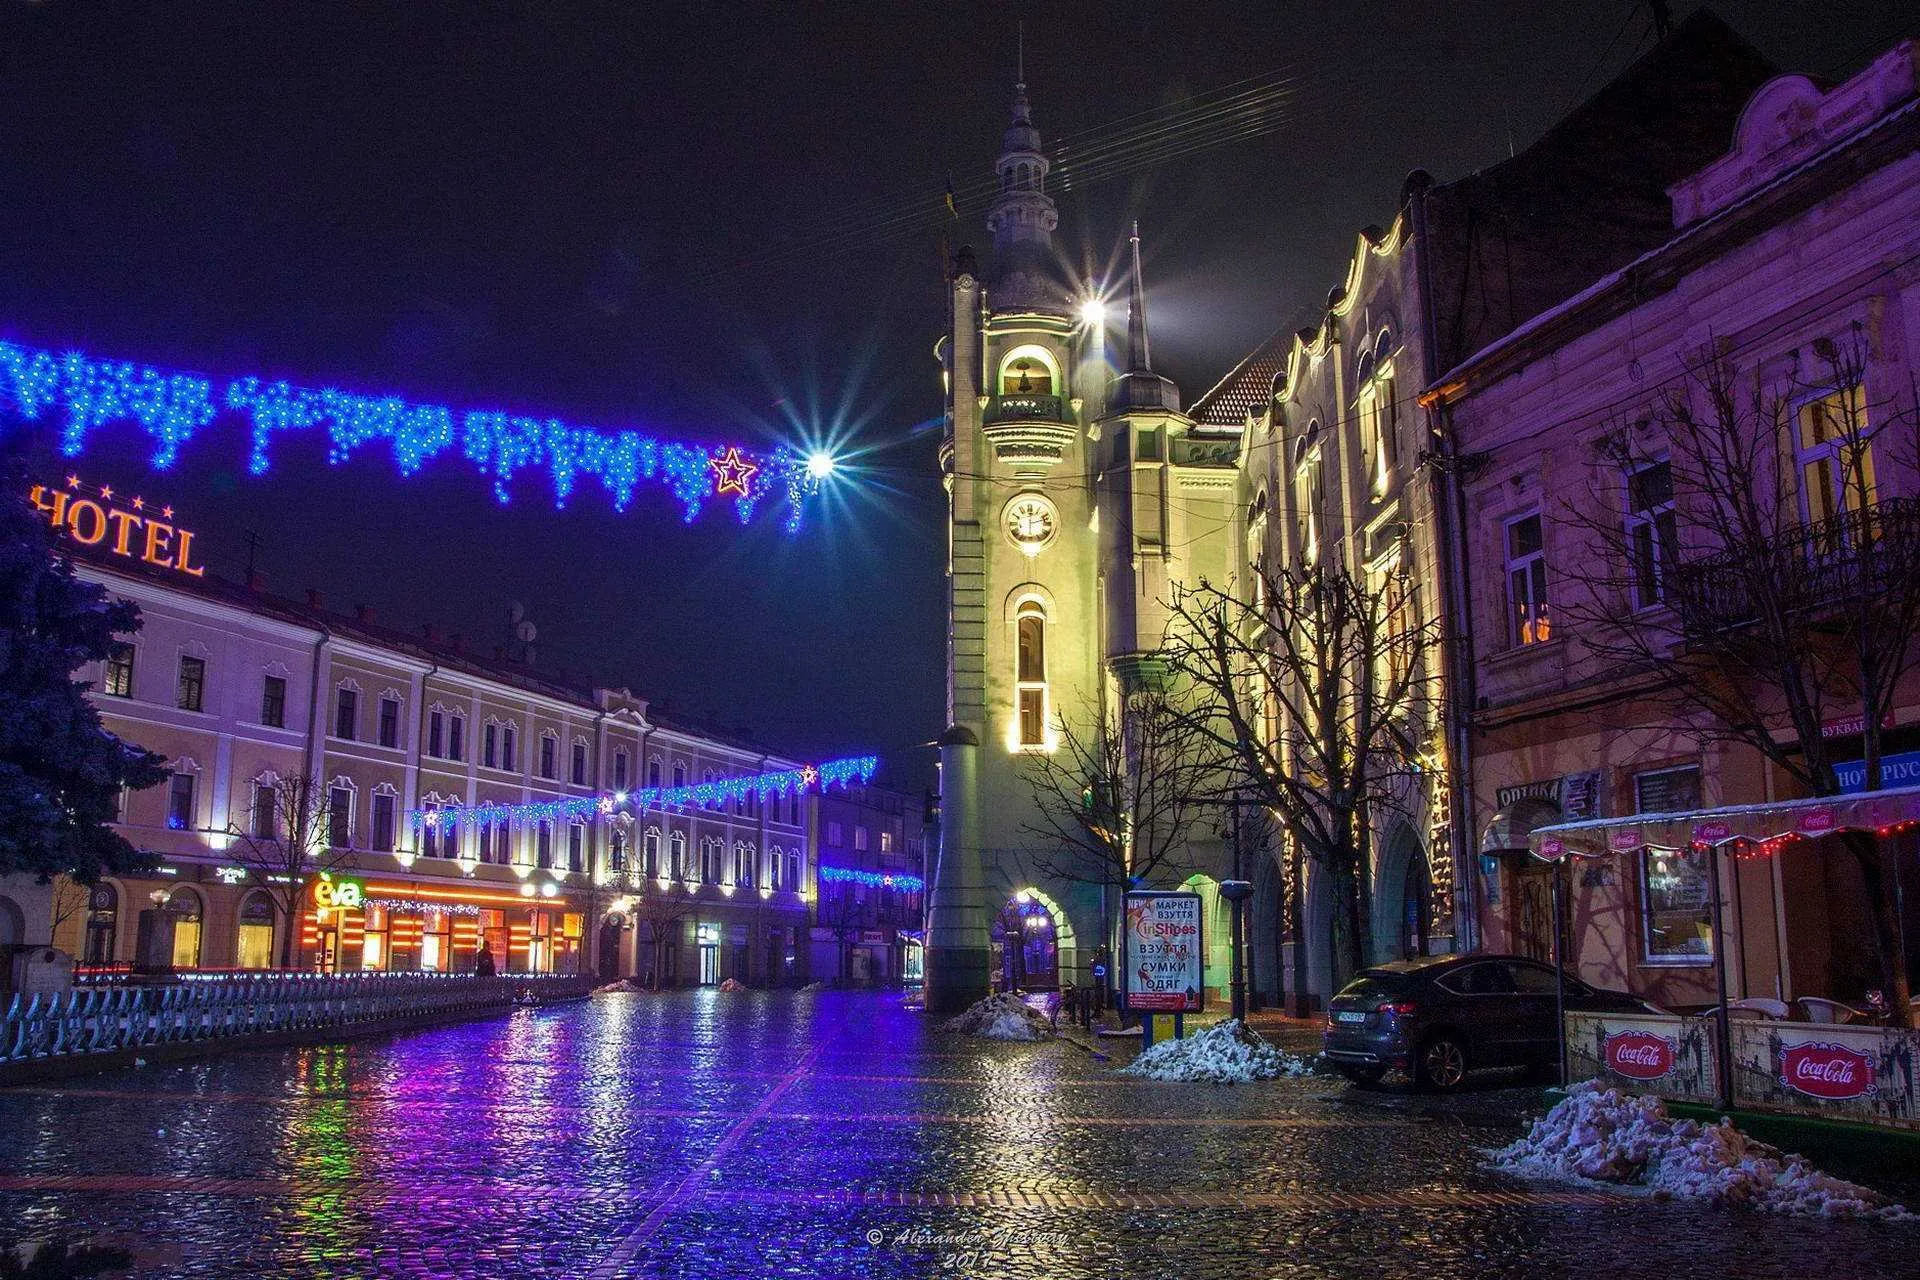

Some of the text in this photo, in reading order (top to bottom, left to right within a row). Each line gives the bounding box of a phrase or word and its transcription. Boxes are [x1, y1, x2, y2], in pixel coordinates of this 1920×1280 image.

[31, 485, 204, 577] HOTEL
[1156, 901, 1194, 910] МАРКЕТ
[1158, 911, 1193, 919] ВЗУТТЯ
[1140, 944, 1187, 954] ВЗУТТЯ
[1141, 962, 1186, 973] СУМКИ
[1147, 980, 1181, 991] ОДЯГ
